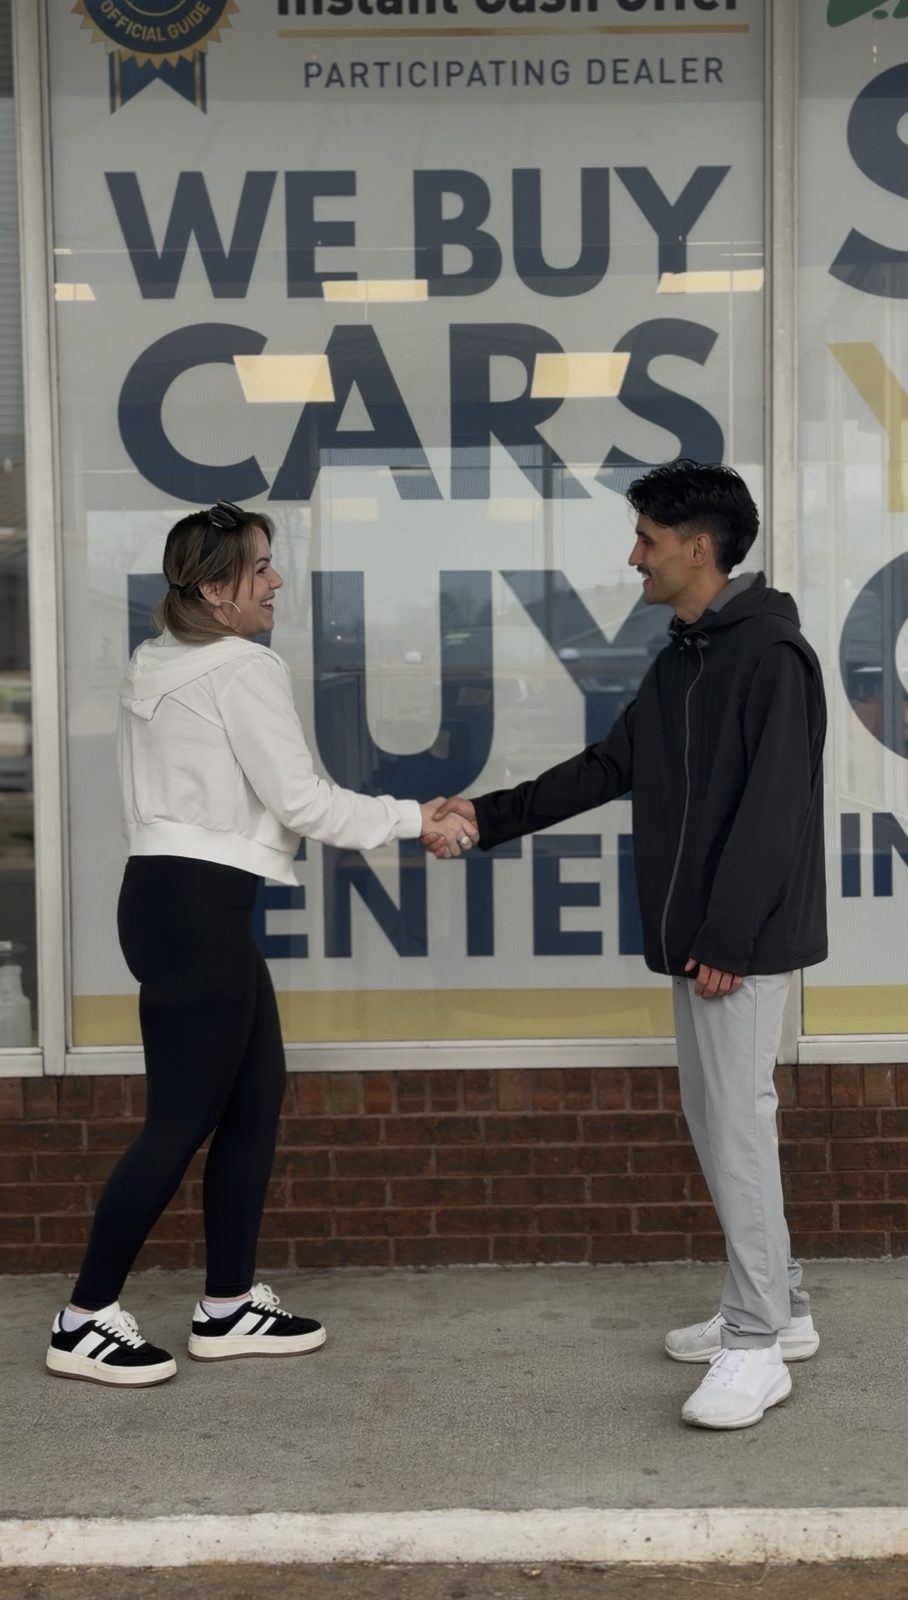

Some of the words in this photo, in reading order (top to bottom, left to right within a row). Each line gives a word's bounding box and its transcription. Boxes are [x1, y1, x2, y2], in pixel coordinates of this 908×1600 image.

[100, 0, 167, 42] OFFICIAL
[167, 2, 211, 39] GUIDE
[304, 60, 570, 88] PARTICIPATING
[587, 57, 723, 85] DEALER
[104, 170, 358, 299] WE
[413, 165, 732, 298] BUY
[118, 317, 724, 504] CARS
[127, 570, 676, 802] UY
